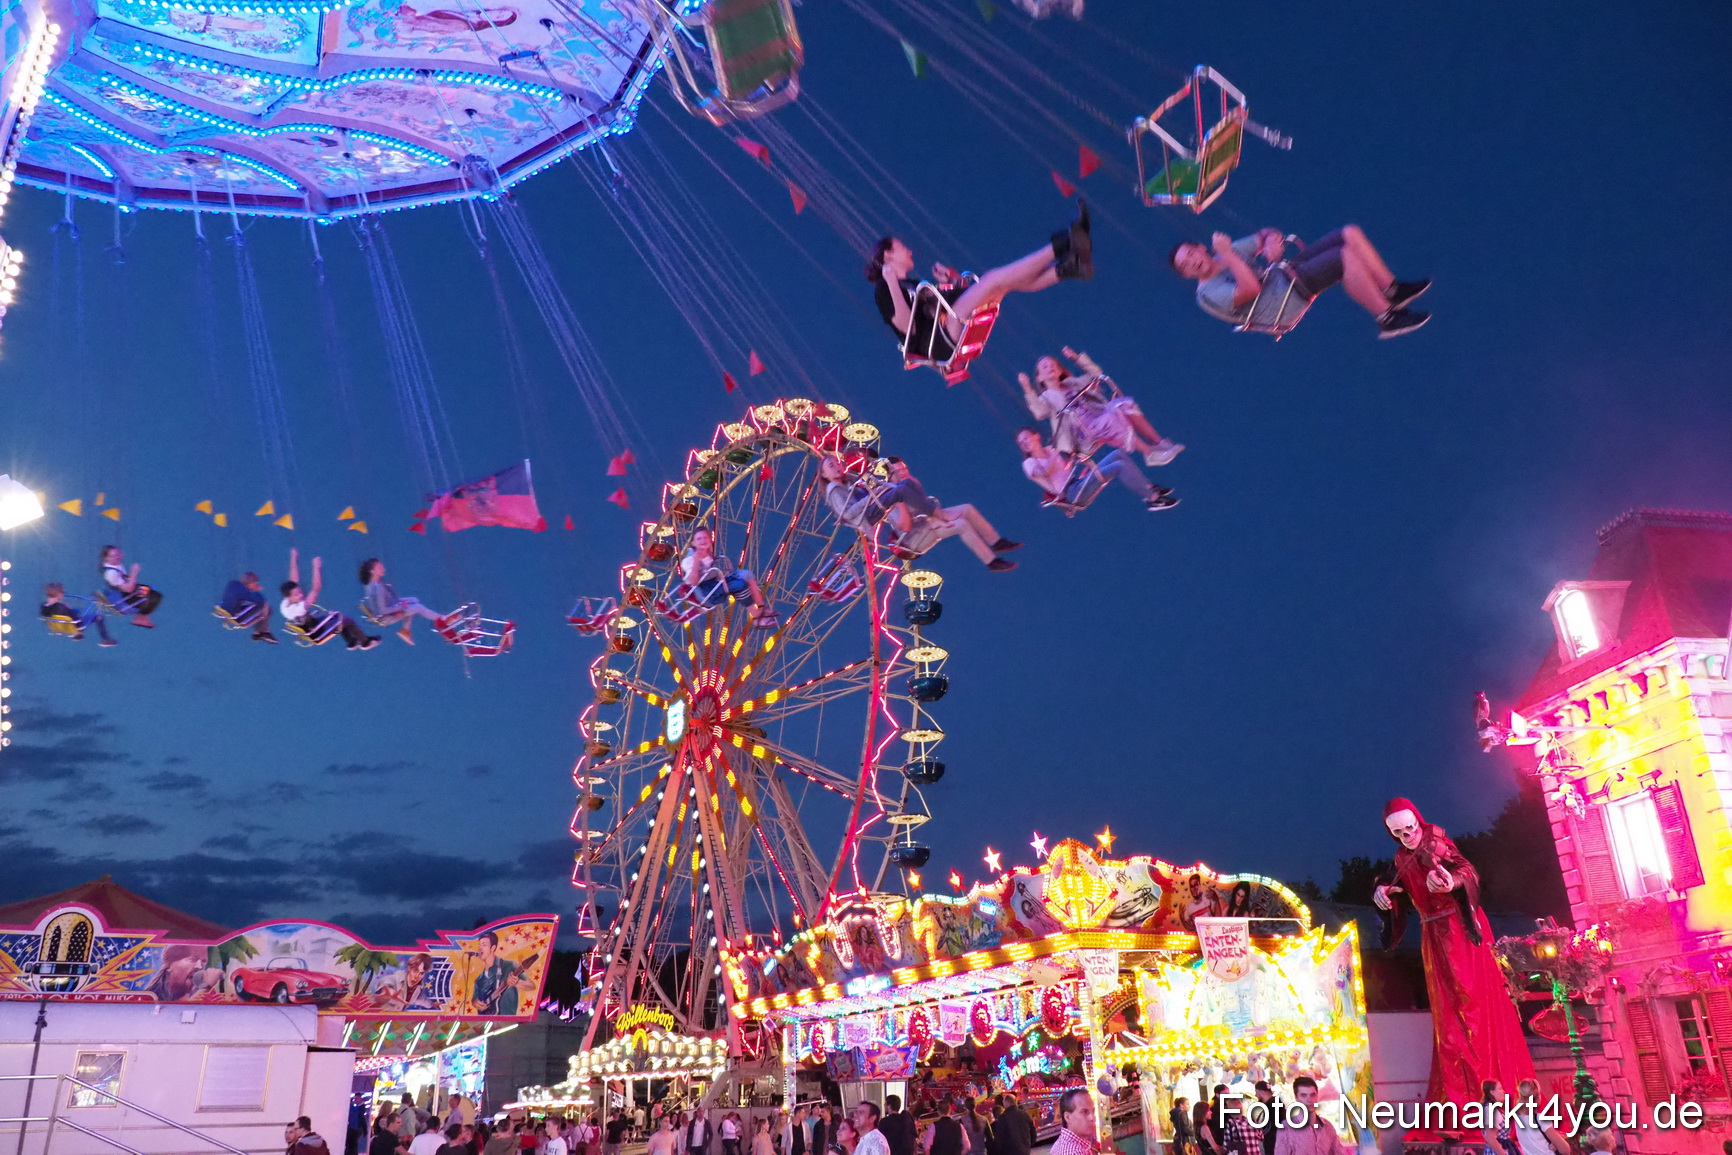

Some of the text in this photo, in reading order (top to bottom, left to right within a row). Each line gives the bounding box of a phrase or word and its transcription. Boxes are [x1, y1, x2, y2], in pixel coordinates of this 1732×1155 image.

[1205, 935, 1242, 948] ENTEN-
[1208, 947, 1247, 961] ANGELN
[1085, 956, 1112, 966] NTEN-
[616, 1003, 674, 1032] Willenborg
